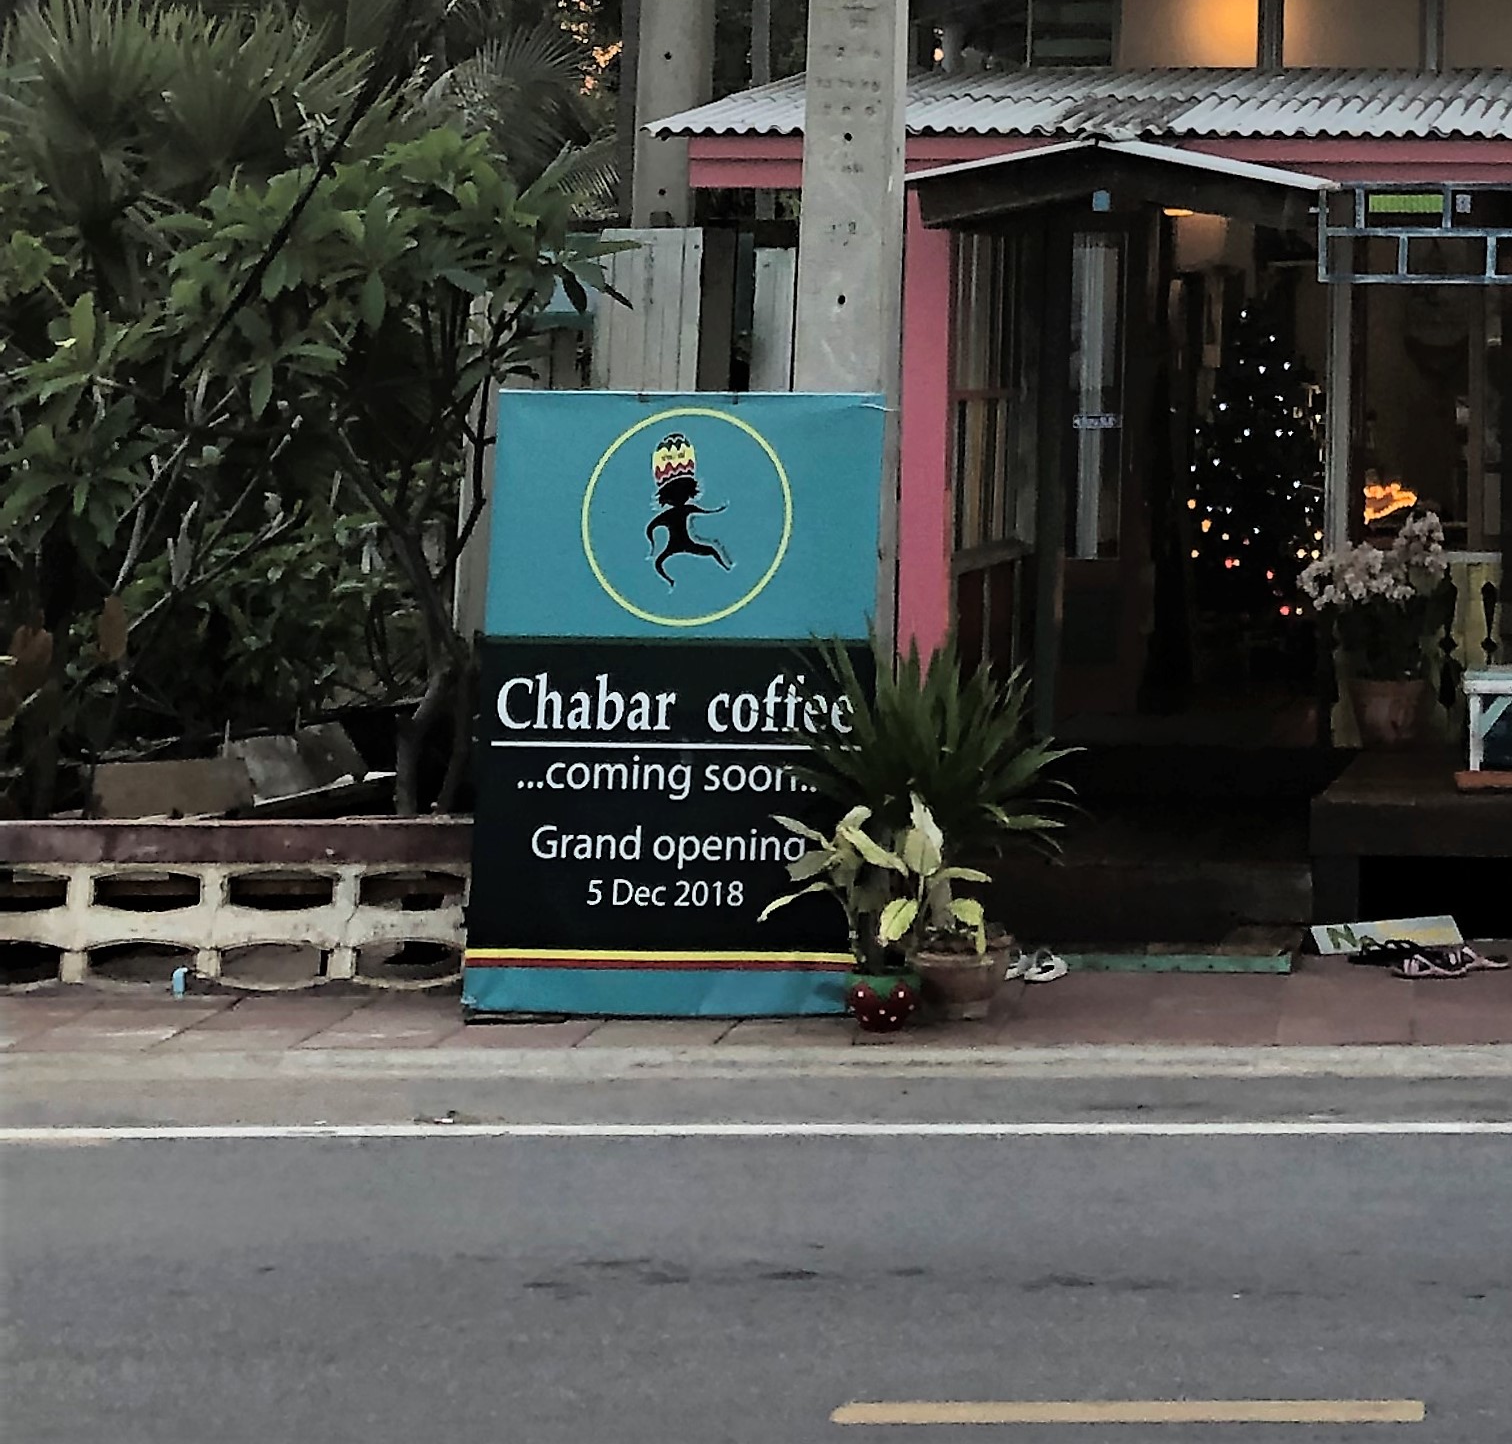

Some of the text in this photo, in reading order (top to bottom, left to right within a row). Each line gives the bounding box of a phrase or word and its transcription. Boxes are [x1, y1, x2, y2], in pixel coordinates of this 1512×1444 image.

[496, 672, 856, 734] Chabar coffee
[516, 755, 692, 800] ...coming
[531, 825, 643, 862] Grand
[586, 879, 744, 907] 5 Dec 2018
